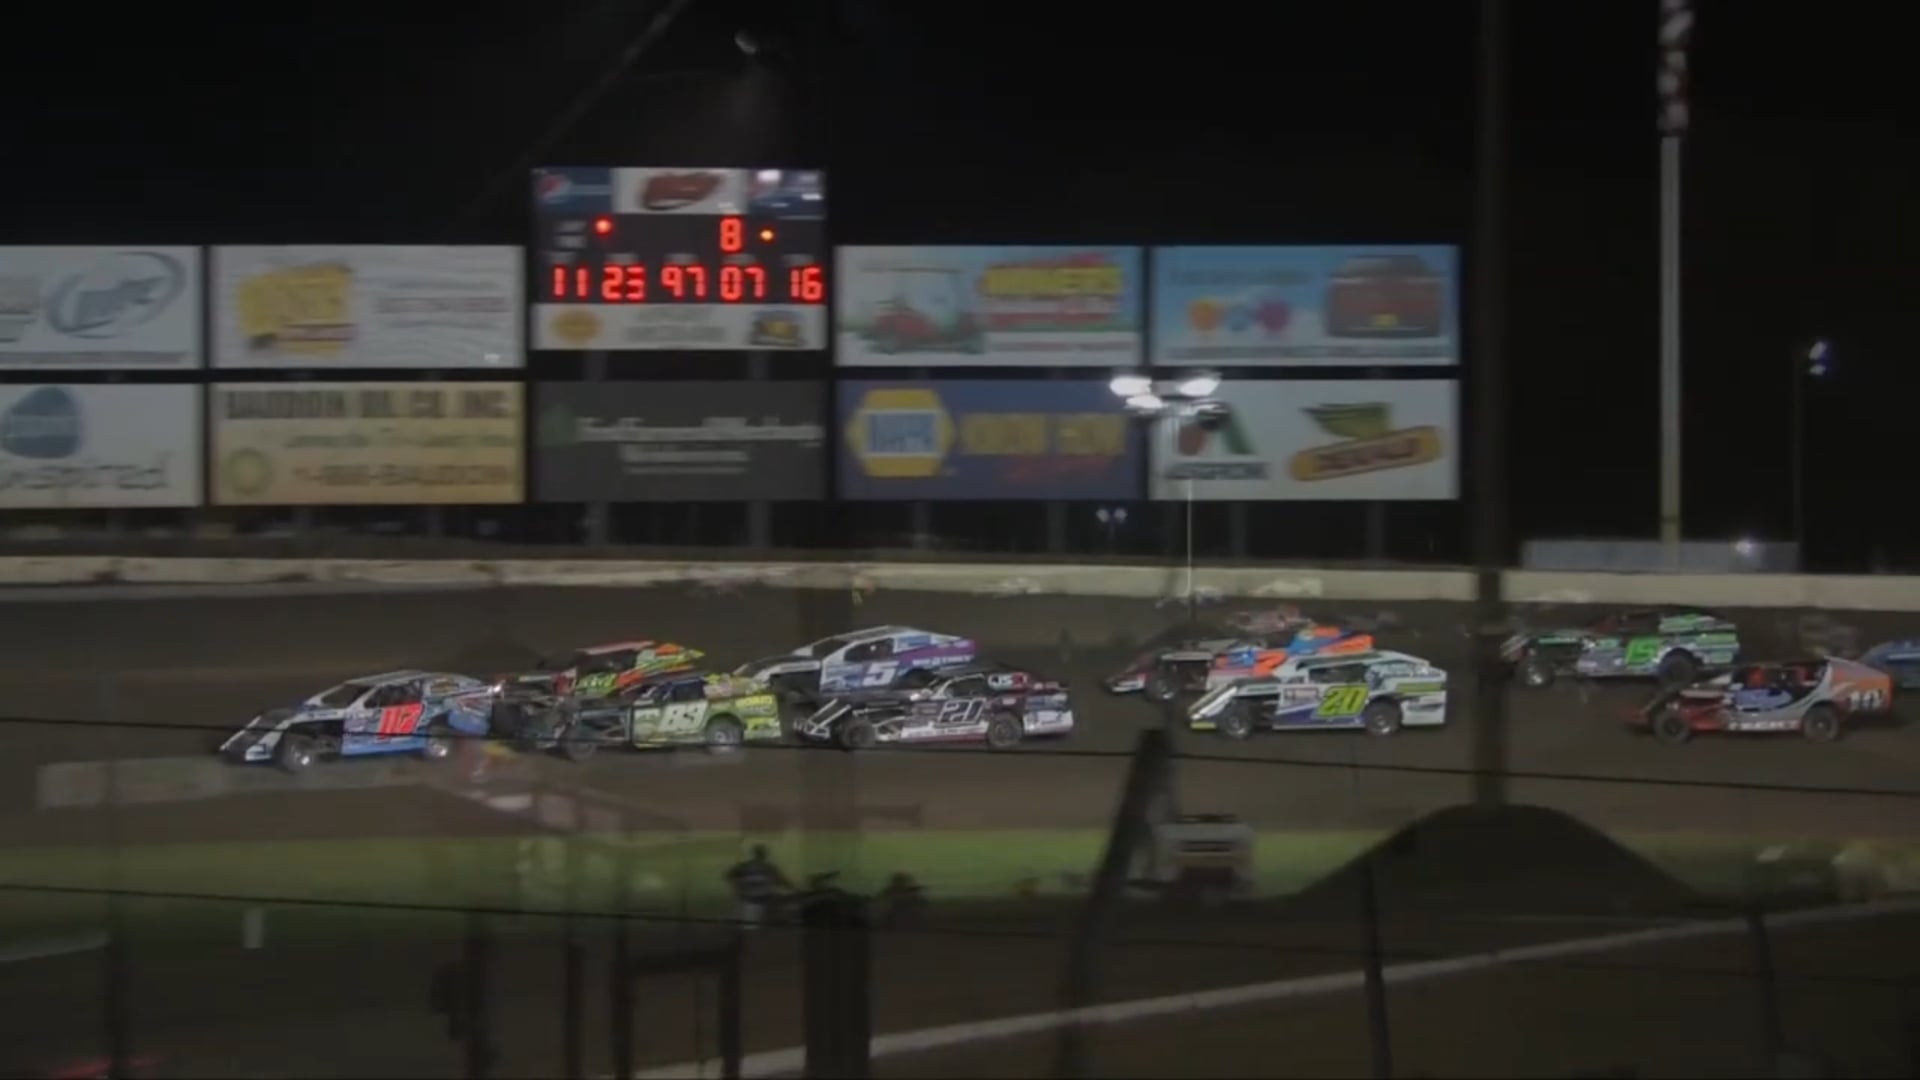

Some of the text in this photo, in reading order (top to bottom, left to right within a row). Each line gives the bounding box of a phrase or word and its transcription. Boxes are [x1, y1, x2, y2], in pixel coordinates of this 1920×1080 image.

[720, 215, 744, 252] 8
[552, 265, 824, 301] 11 23 97 07 16
[861, 660, 898, 686] 5
[938, 697, 988, 724] 21
[1316, 685, 1369, 717] 20
